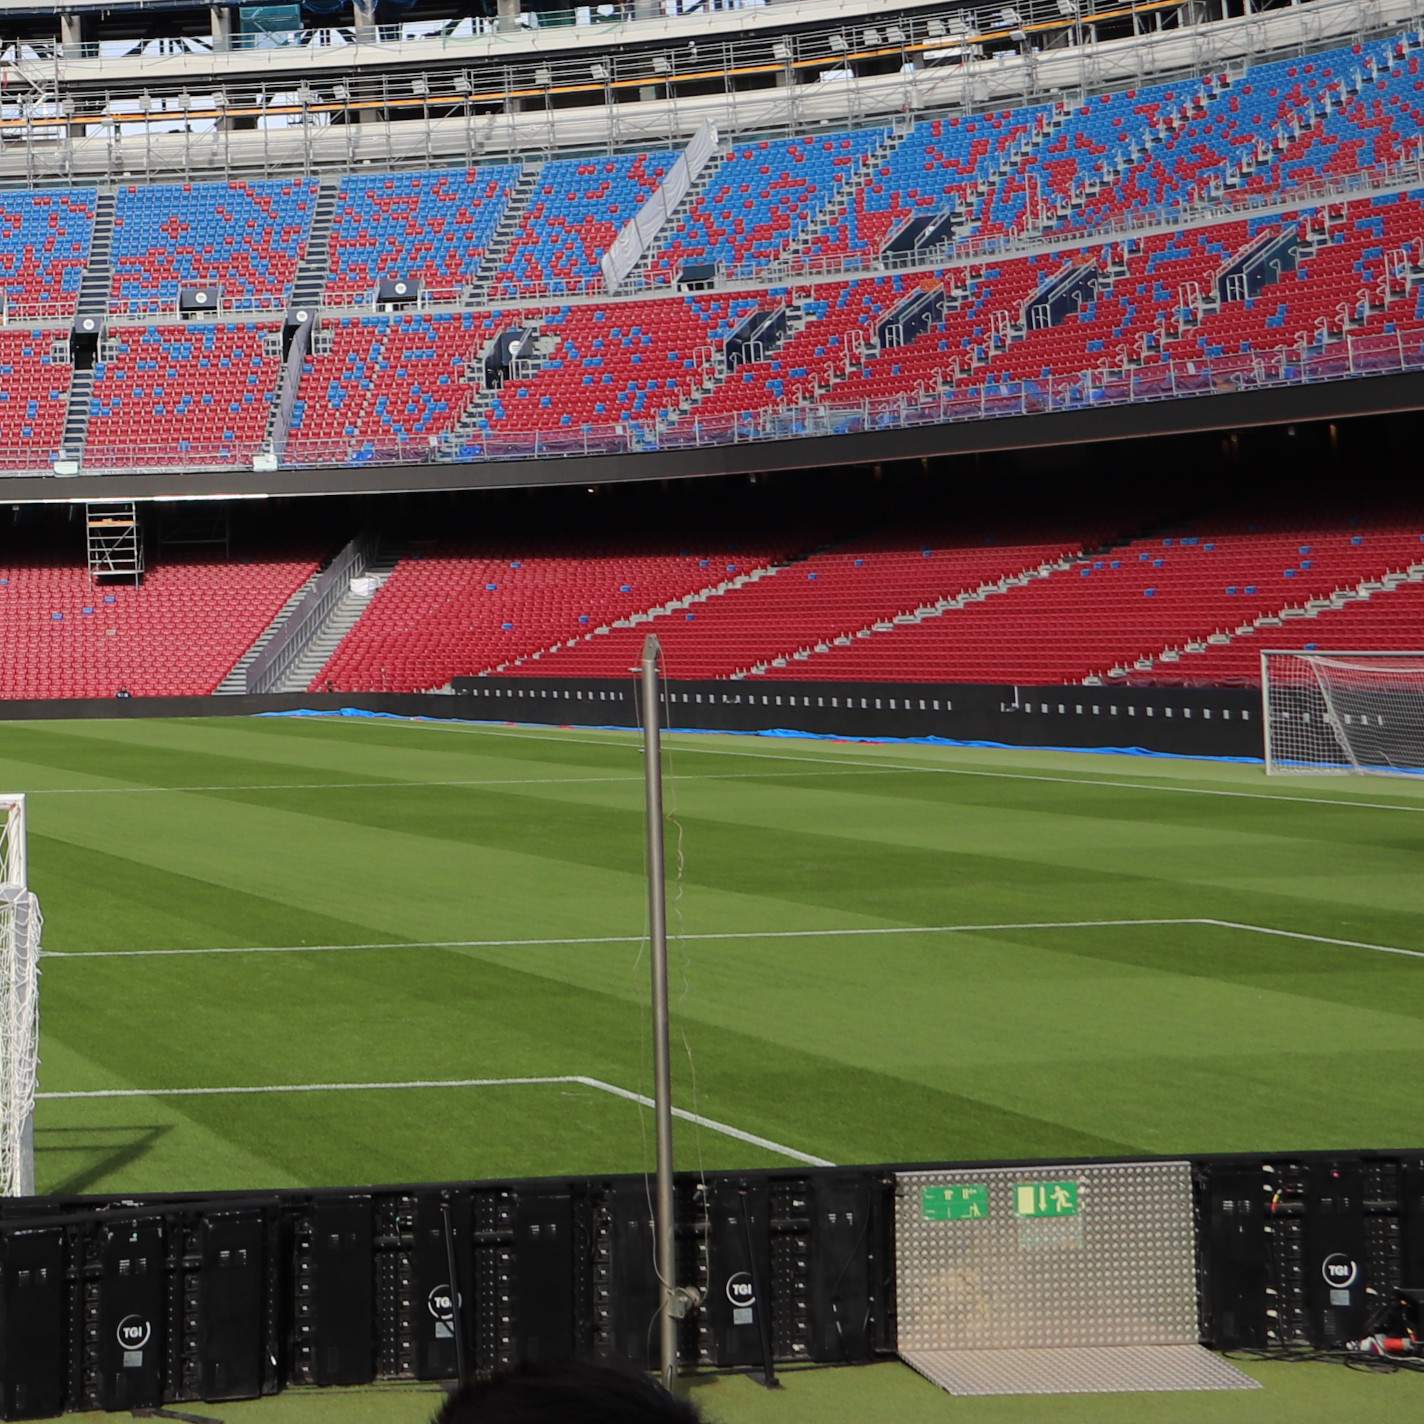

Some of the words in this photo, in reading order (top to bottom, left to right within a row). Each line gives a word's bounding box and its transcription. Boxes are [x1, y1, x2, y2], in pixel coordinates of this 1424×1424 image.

[1328, 1265, 1349, 1276] TGI
[733, 1284, 752, 1295] TGI
[434, 1297, 452, 1308] TG
[123, 1327, 142, 1338] TGI
